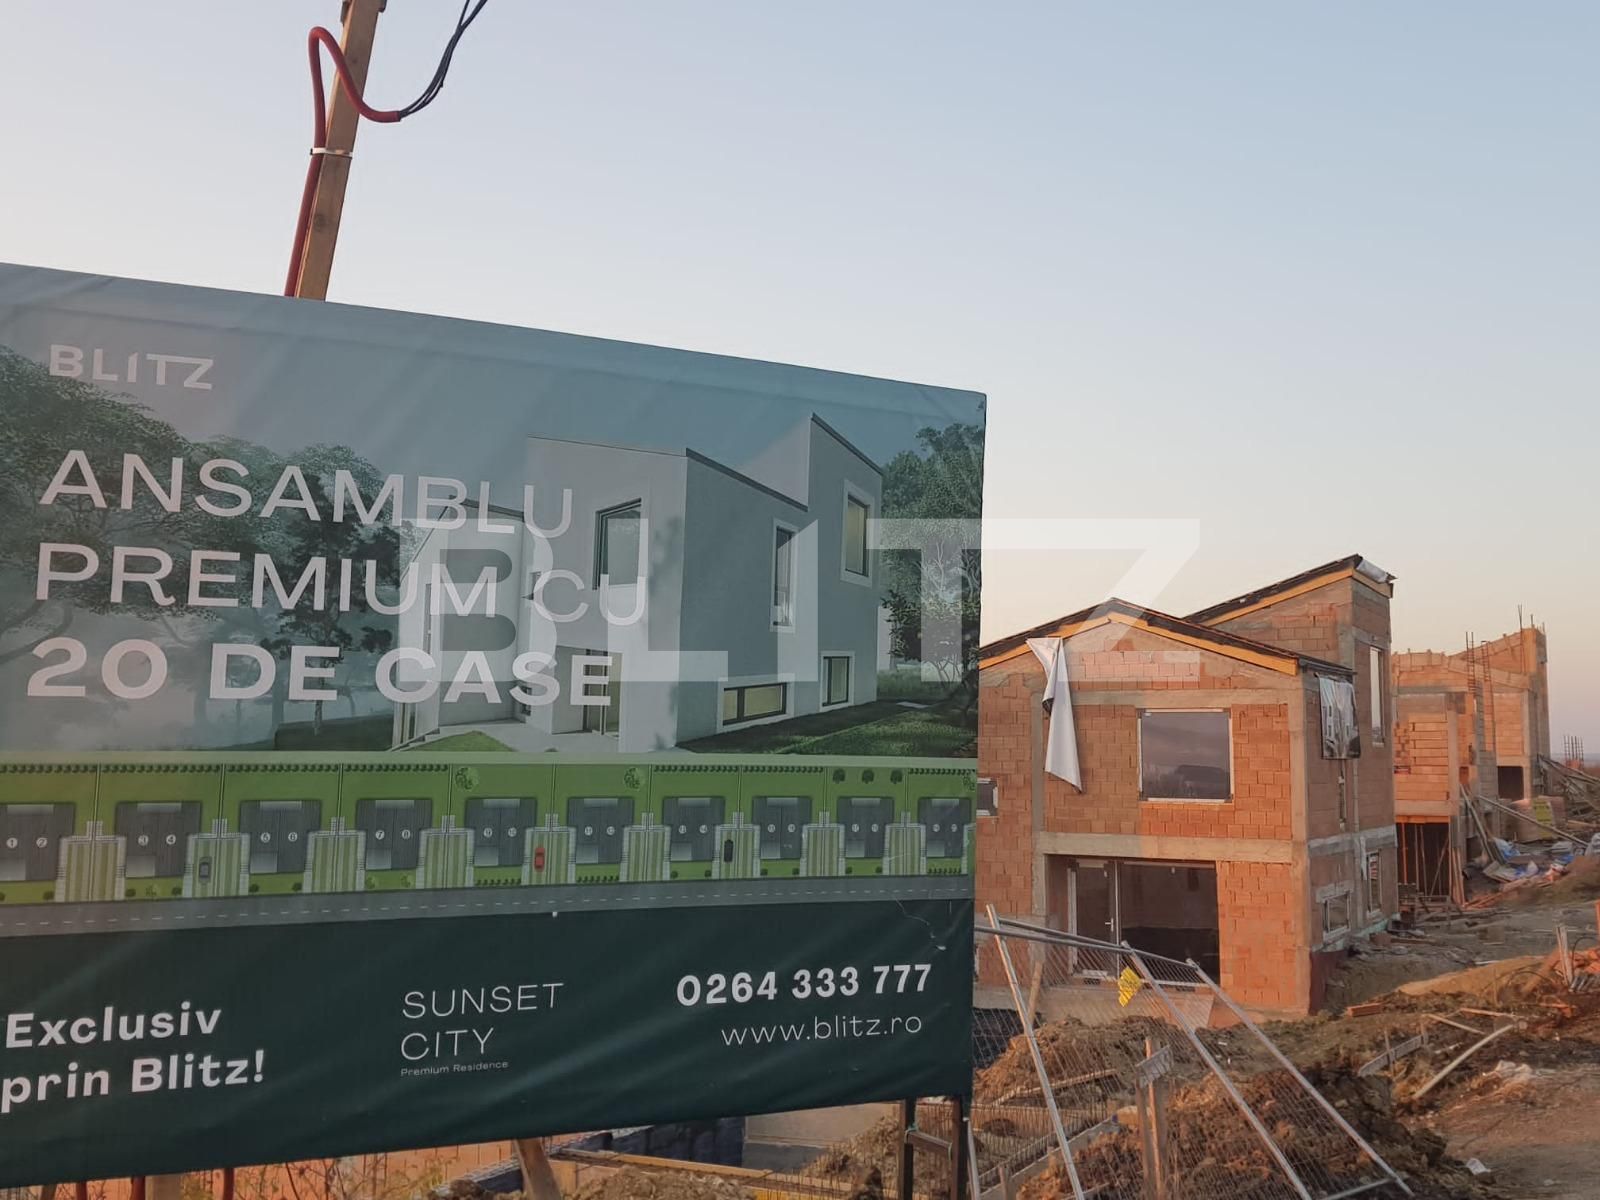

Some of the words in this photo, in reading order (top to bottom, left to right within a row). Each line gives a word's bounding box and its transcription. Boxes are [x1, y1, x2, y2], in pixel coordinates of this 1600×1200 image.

[49, 344, 214, 390] BLITZ
[39, 449, 573, 538] ANSAMBLU
[36, 542, 498, 618] PREMIUM
[532, 569, 647, 626] CU
[27, 637, 168, 699] 20
[209, 643, 340, 700] DE
[375, 647, 613, 706] CASE
[402, 982, 564, 1019] SUNSET
[676, 971, 777, 1007] 0264
[791, 966, 860, 999] 333
[873, 963, 932, 994] 777
[6, 1001, 222, 1048] Exclusiv
[401, 1027, 494, 1060] CITY
[721, 1015, 922, 1046] www.blitz.ro
[1, 1061, 109, 1113] prin
[132, 1048, 264, 1093] Blitz!
[401, 1064, 450, 1077] Premium
[453, 1060, 509, 1073] Residence
